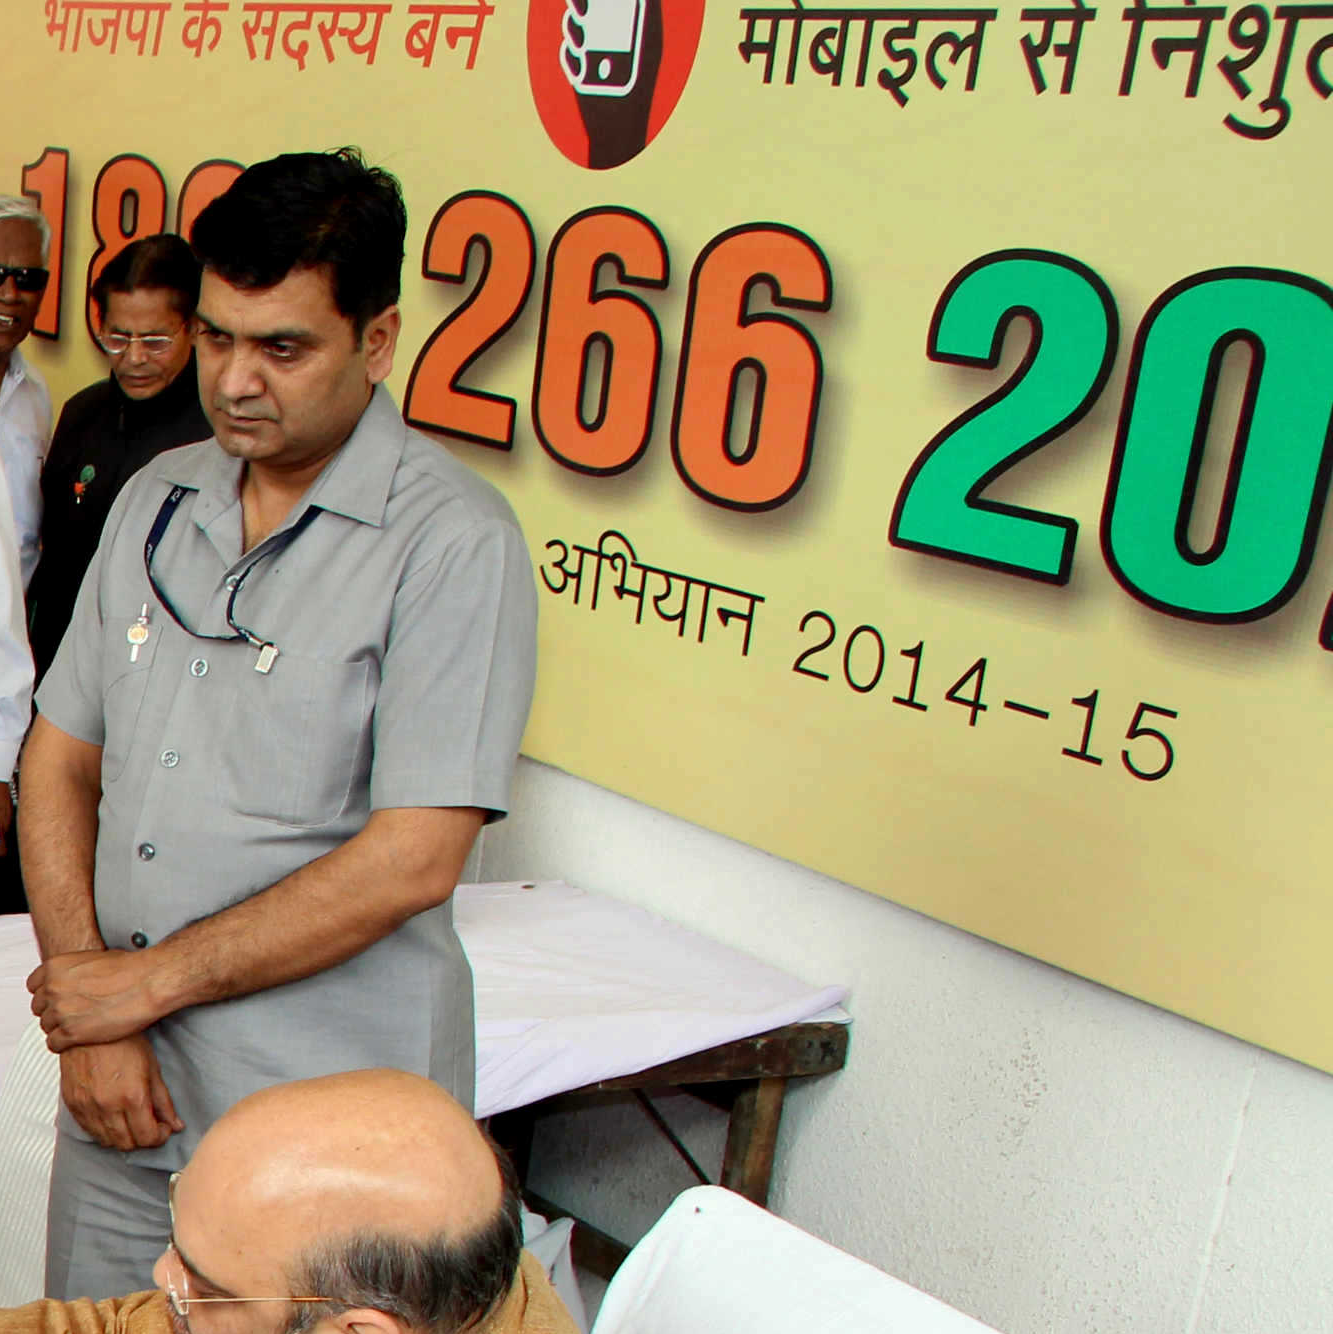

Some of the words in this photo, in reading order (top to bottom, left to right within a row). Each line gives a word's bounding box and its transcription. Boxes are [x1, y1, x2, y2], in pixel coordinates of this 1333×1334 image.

[44, 0, 171, 56] भाजपा
[181, 0, 229, 58] क
[240, 3, 393, 72] सदस्य
[1019, 0, 1097, 96] स
[402, 188, 833, 514] 266
[888, 247, 1333, 652] 20
[539, 529, 765, 657] अभियान
[792, 609, 1179, 782] 2014-15
